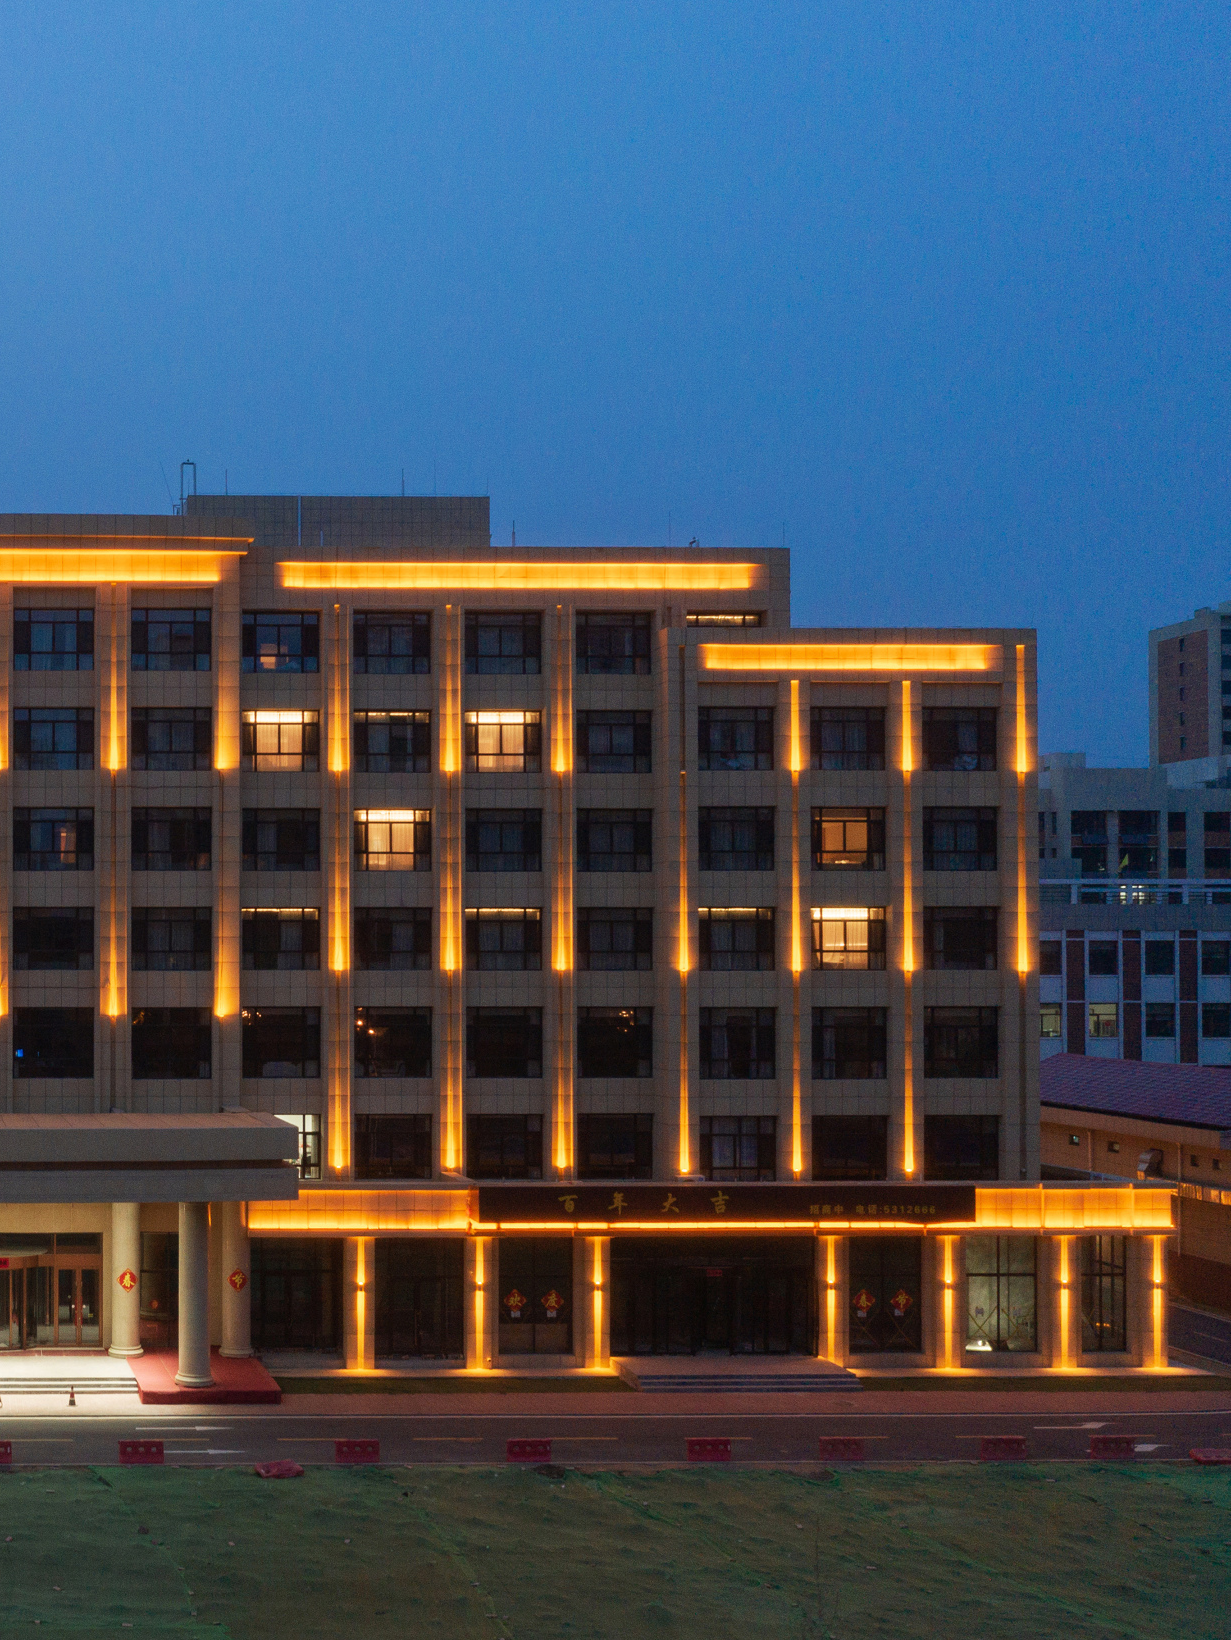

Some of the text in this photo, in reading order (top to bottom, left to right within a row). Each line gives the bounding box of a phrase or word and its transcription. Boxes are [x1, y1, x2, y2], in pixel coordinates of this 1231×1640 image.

[558, 1190, 729, 1214] 百年大吉
[121, 1272, 135, 1287] 春
